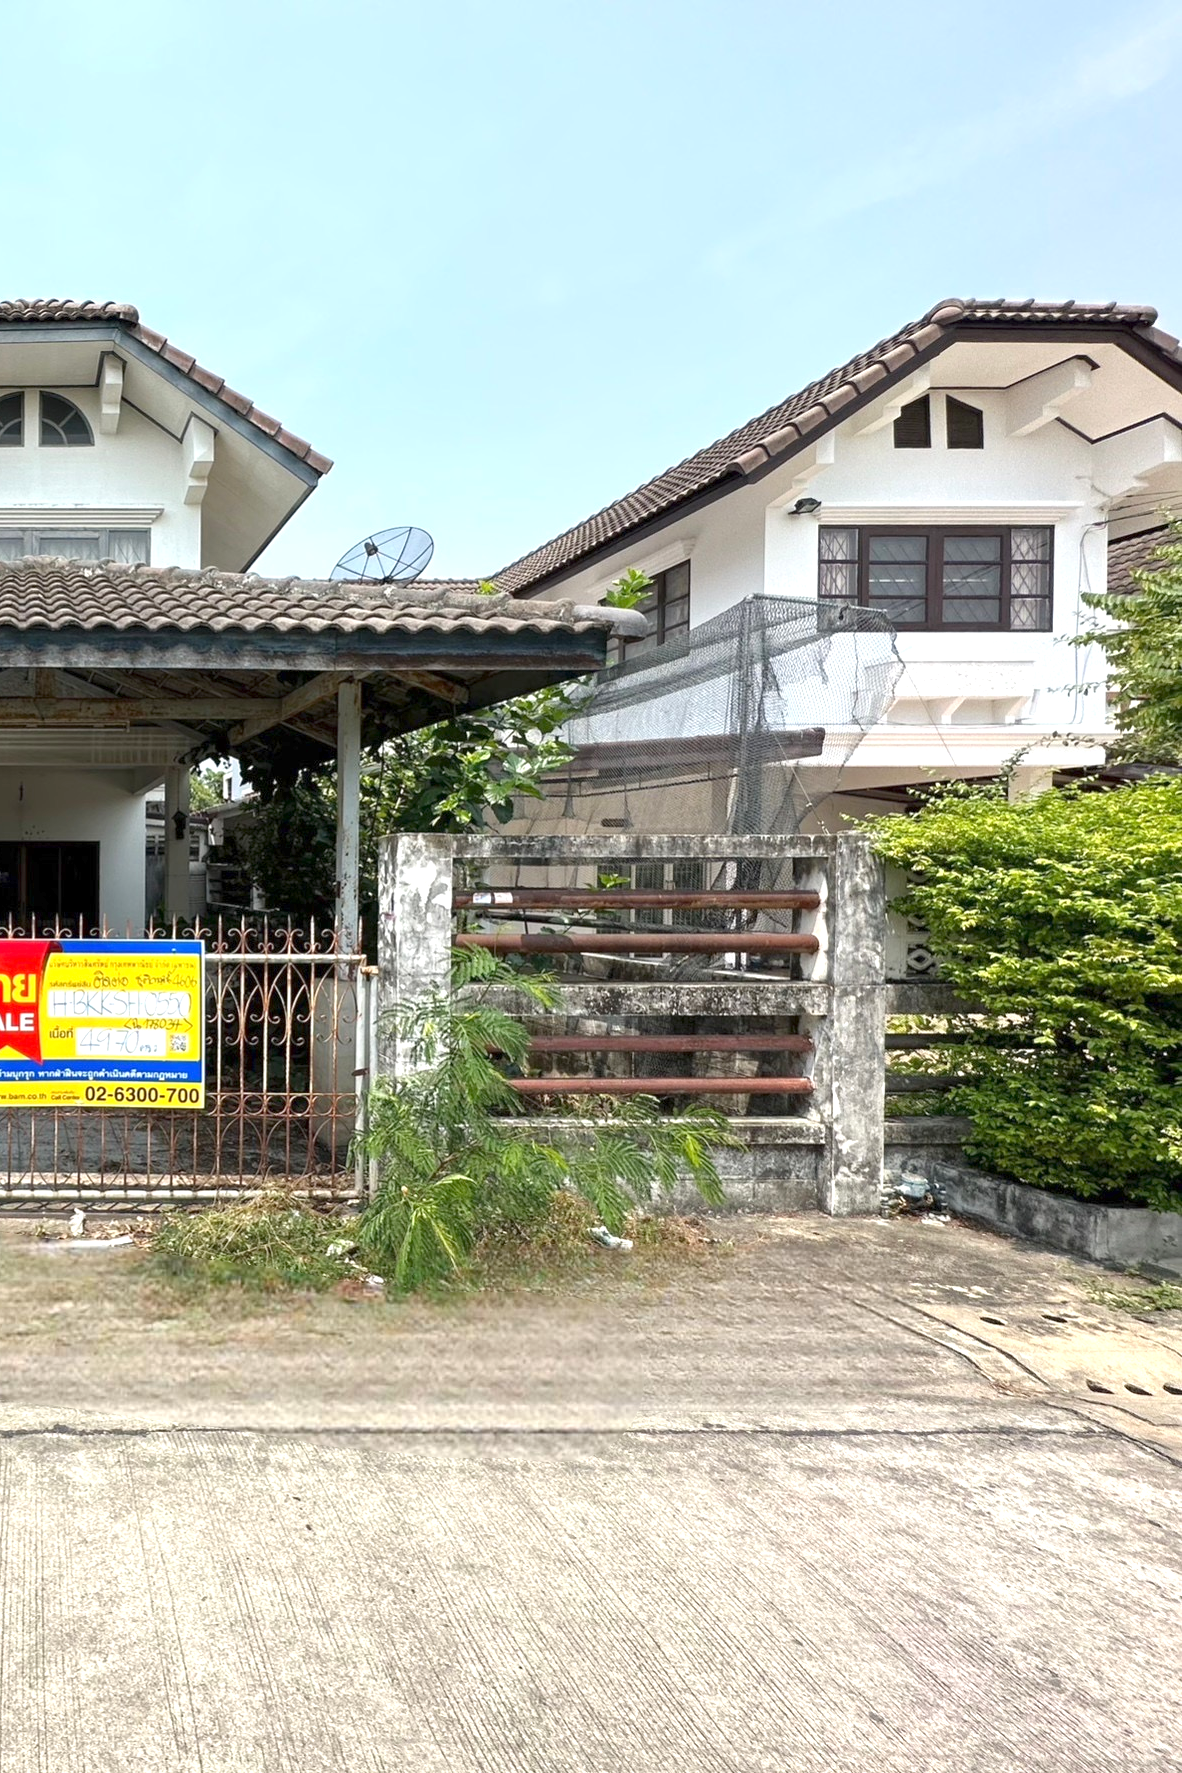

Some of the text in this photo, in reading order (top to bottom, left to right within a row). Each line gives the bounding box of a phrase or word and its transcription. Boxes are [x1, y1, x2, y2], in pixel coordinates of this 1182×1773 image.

[49, 1025, 74, 1039] เนื้อที่
[84, 1086, 200, 1104] 02-6300-700
